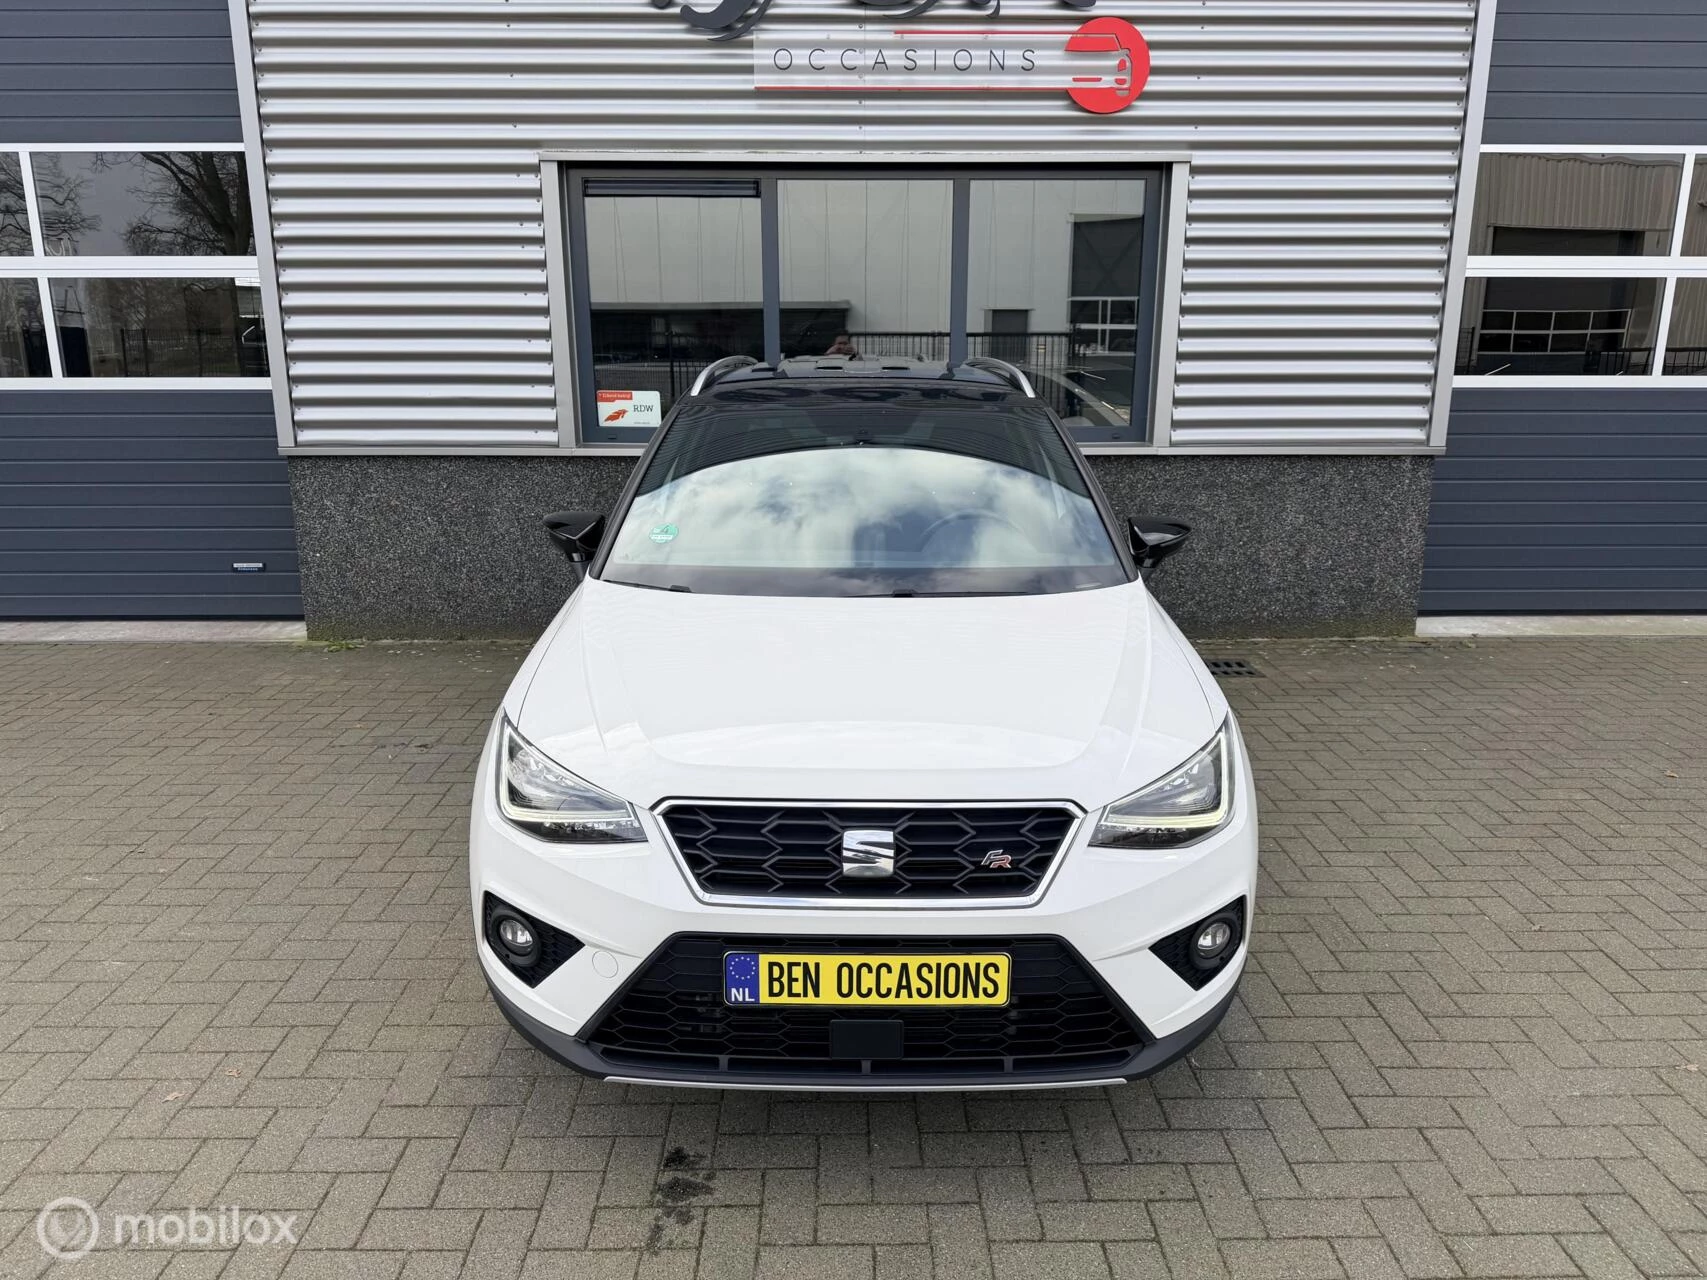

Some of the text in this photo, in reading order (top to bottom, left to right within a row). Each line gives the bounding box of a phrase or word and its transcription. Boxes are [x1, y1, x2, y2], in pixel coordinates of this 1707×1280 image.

[773, 47, 1037, 72] OCCASIONS
[633, 405, 653, 413] RDW
[981, 850, 1011, 868] FR
[767, 961, 1000, 999] BEN OCCASIONS
[731, 988, 755, 1002] NL
